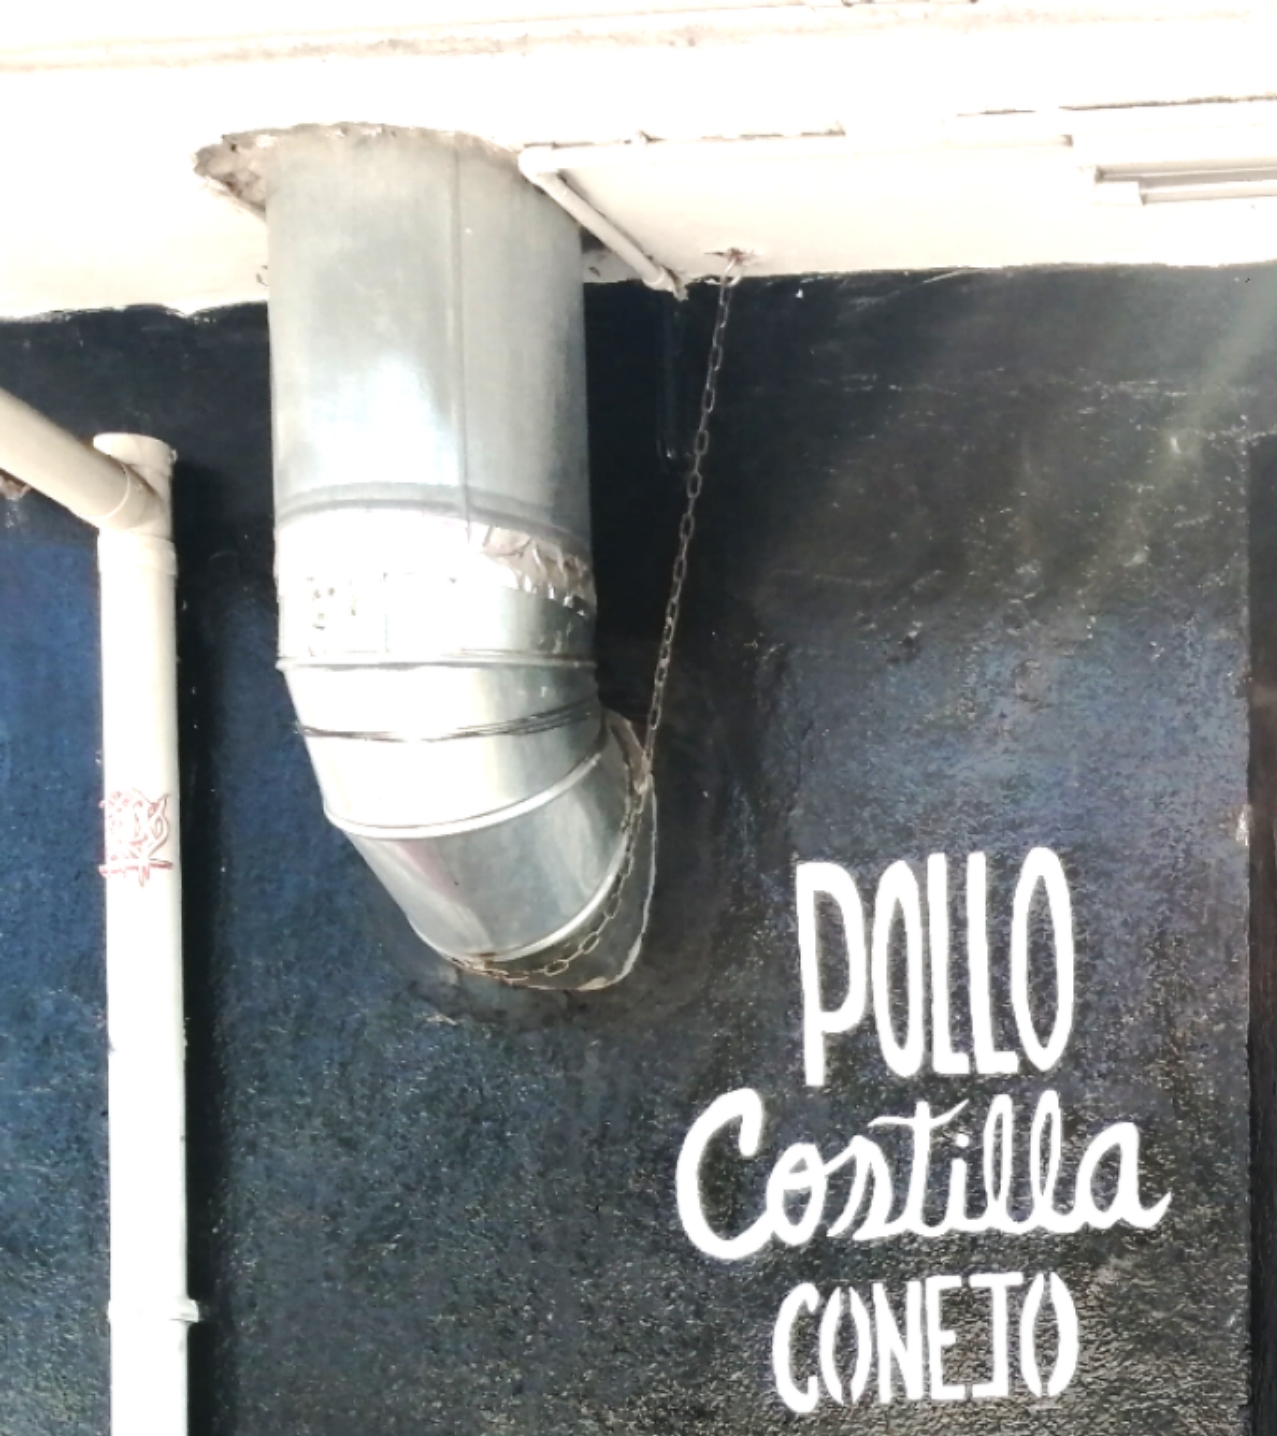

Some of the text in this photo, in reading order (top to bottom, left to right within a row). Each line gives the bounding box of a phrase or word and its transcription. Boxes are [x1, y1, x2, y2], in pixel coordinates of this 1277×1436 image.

[796, 846, 1074, 1087] POLLO
[675, 1087, 1172, 1260] Costilla
[772, 1271, 1080, 1414] CONEJO
